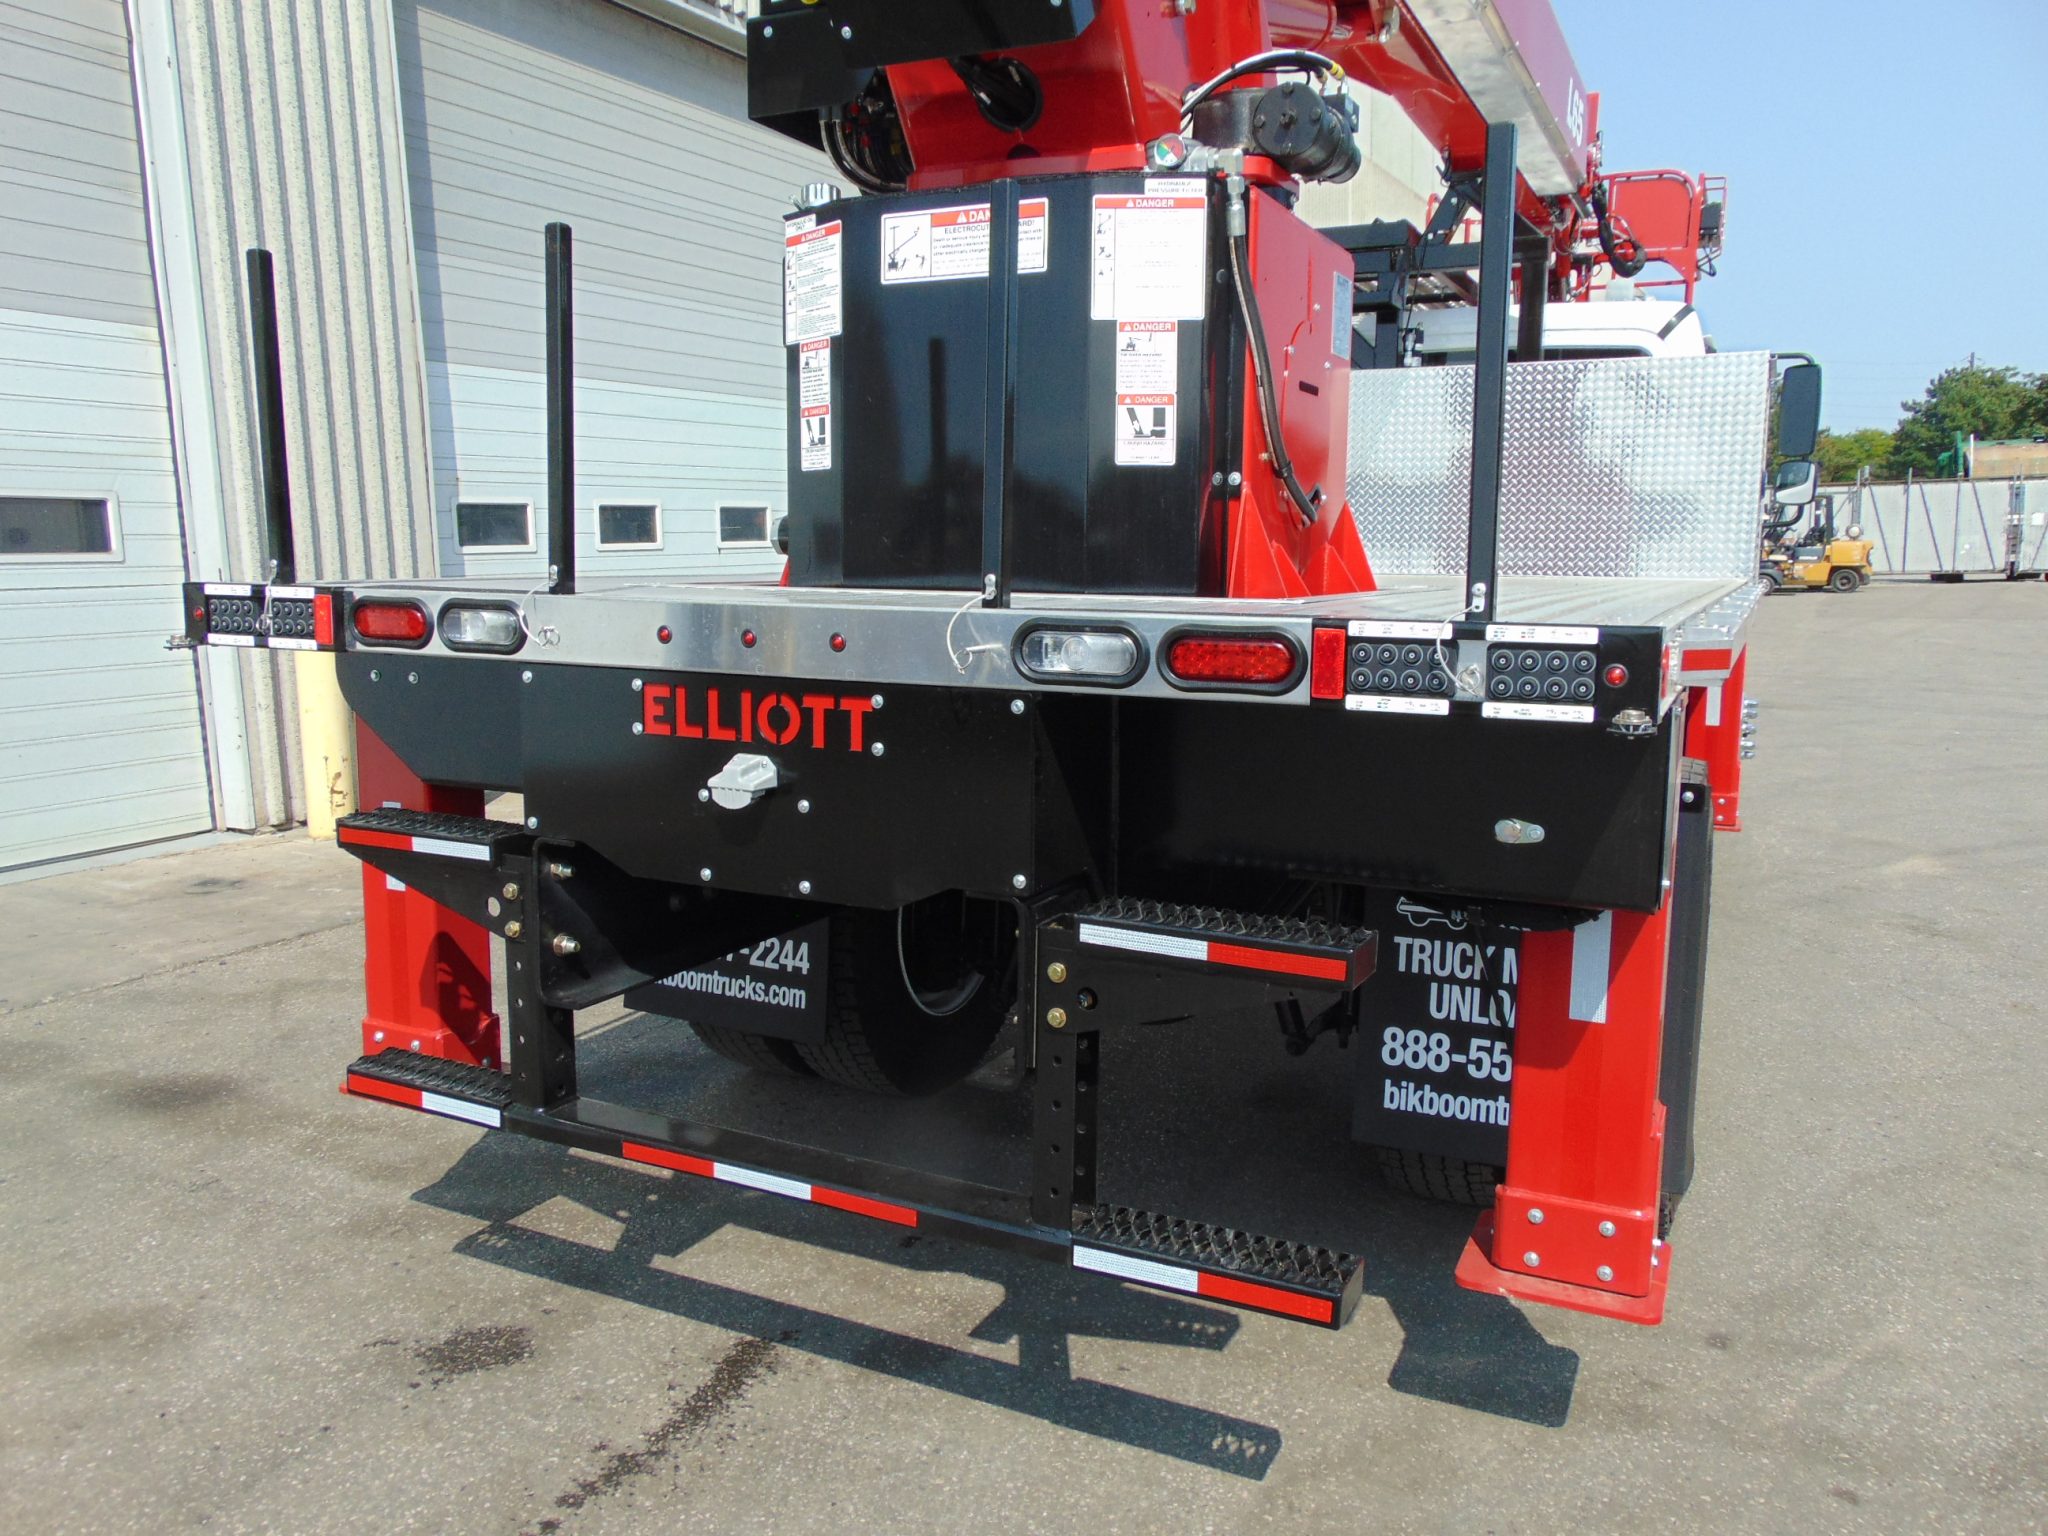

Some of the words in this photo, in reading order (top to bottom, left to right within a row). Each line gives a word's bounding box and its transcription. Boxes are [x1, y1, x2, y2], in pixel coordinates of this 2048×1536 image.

[1566, 76, 1585, 148] L65
[1135, 199, 1175, 208] DANGER
[968, 207, 991, 223] DAN
[804, 229, 826, 240] DANGER
[944, 224, 990, 235] ELECTROCUT
[1132, 322, 1172, 331] DANGER
[807, 341, 828, 351] DANGER
[1134, 396, 1169, 404] DANGER
[809, 407, 827, 416] DANGER
[642, 682, 874, 752] ELLIOTT
[726, 936, 811, 975] -2244
[1393, 935, 1496, 981] TRUCK
[1502, 947, 1519, 985] M
[655, 970, 807, 1010] boomtrucks.com
[1381, 1026, 1513, 1083] 888-55
[1383, 1078, 1510, 1127] bikboomt
